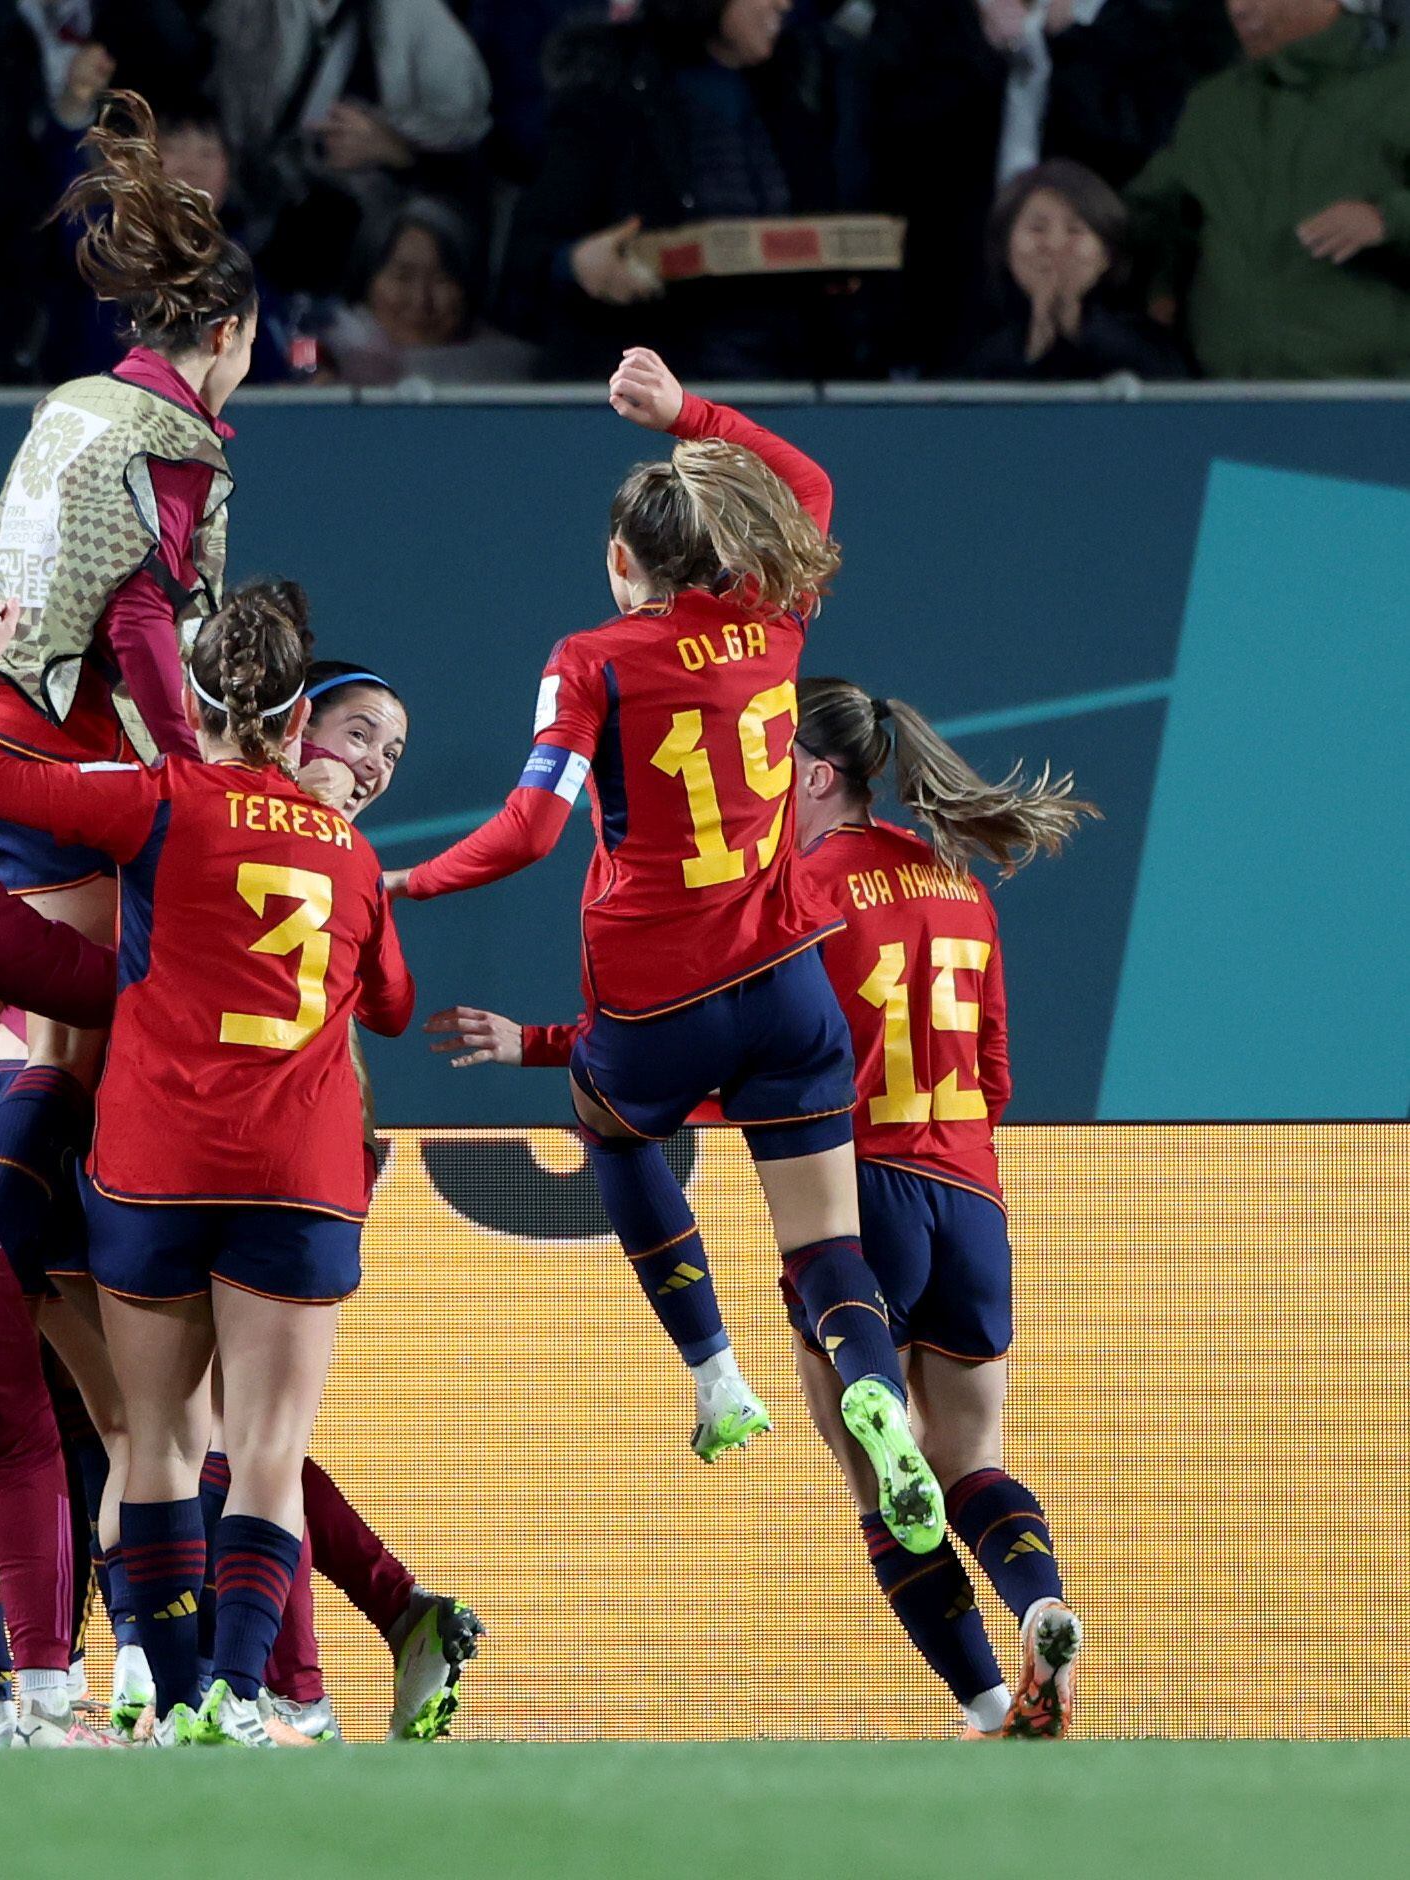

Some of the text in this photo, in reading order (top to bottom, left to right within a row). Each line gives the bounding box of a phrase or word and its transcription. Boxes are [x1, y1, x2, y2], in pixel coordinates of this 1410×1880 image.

[676, 622, 767, 672] OLGA
[224, 790, 353, 851] TERESA
[649, 679, 799, 889] 19
[847, 867, 895, 911] EVA
[218, 861, 333, 1052] 3
[856, 936, 991, 1126] 15
